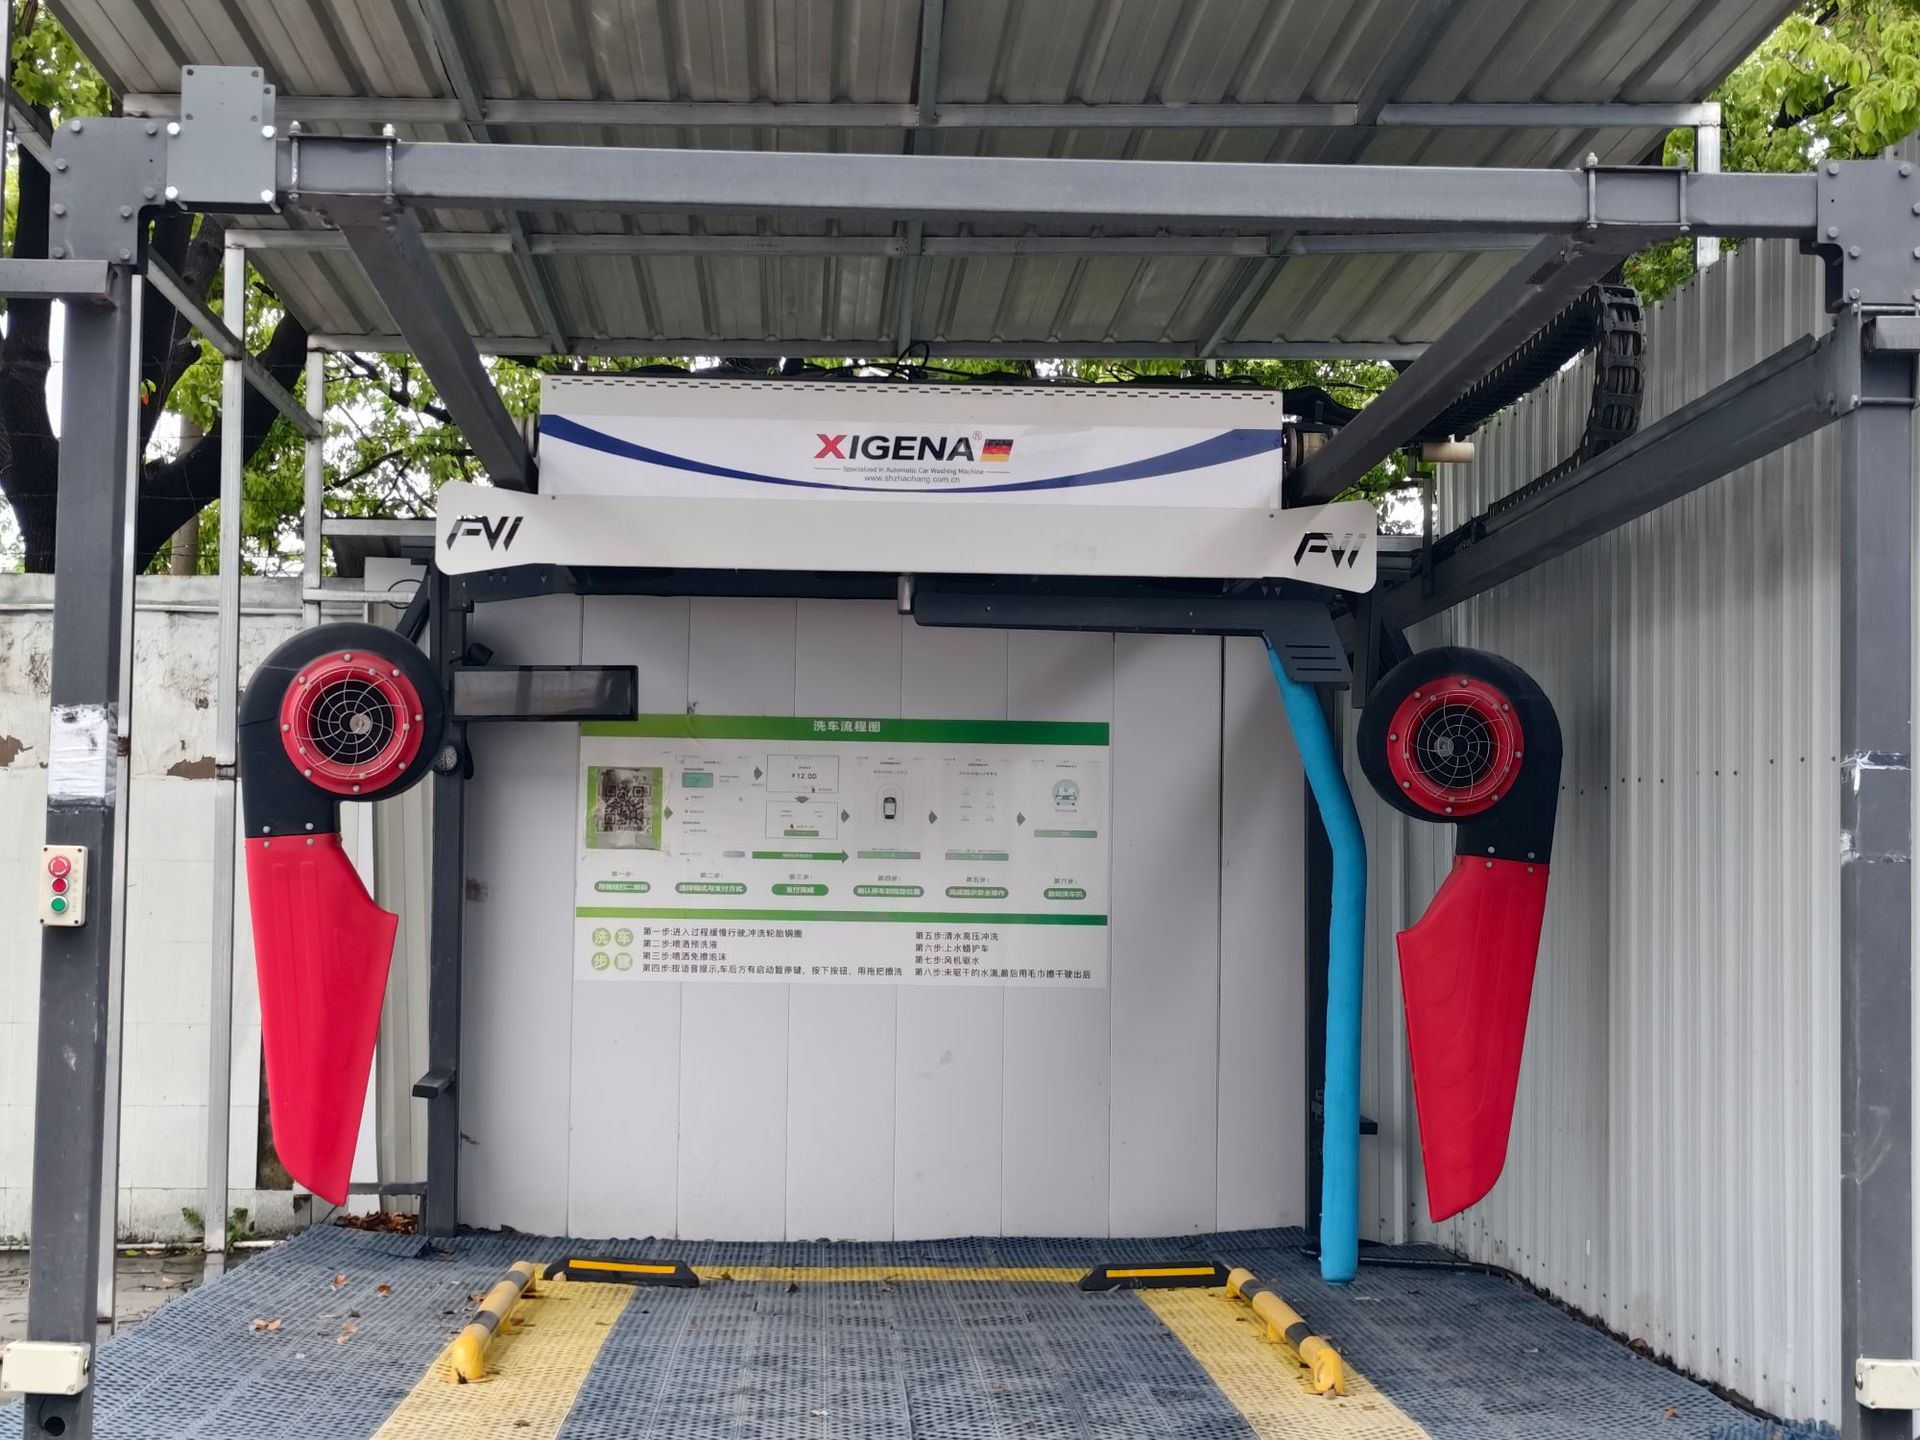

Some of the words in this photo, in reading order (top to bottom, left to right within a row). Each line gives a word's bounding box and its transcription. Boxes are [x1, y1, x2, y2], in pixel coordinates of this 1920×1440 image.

[814, 433, 975, 462] XIGENA
[843, 466, 877, 474] Specialized
[886, 466, 917, 474] Automatic
[918, 467, 929, 475] Car
[930, 467, 957, 476] Washing
[958, 468, 984, 476] Machine
[813, 720, 881, 733] 洗车流程图
